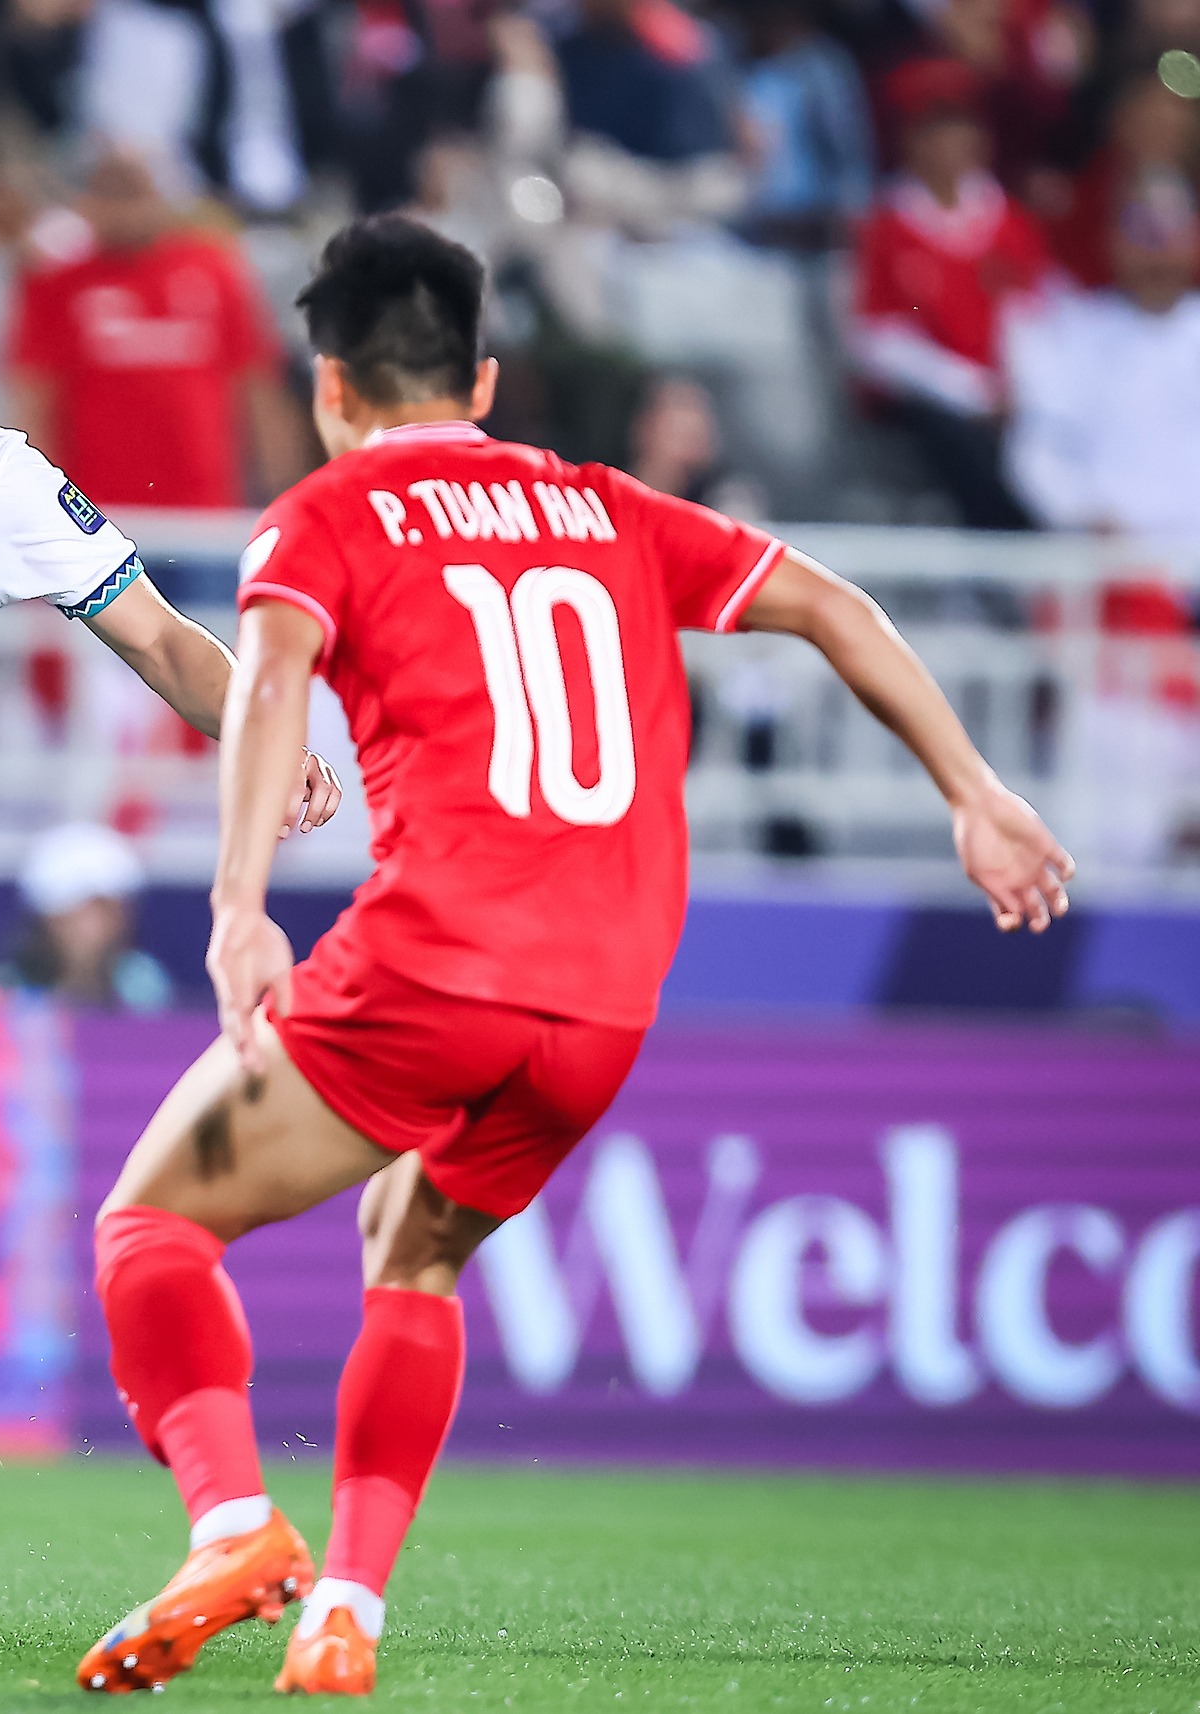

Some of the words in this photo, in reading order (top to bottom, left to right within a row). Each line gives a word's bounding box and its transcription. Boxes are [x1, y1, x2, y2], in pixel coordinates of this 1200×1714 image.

[367, 489, 423, 546] P.
[407, 478, 540, 543] TUAN
[532, 480, 617, 543] HAI
[442, 563, 637, 827] 10
